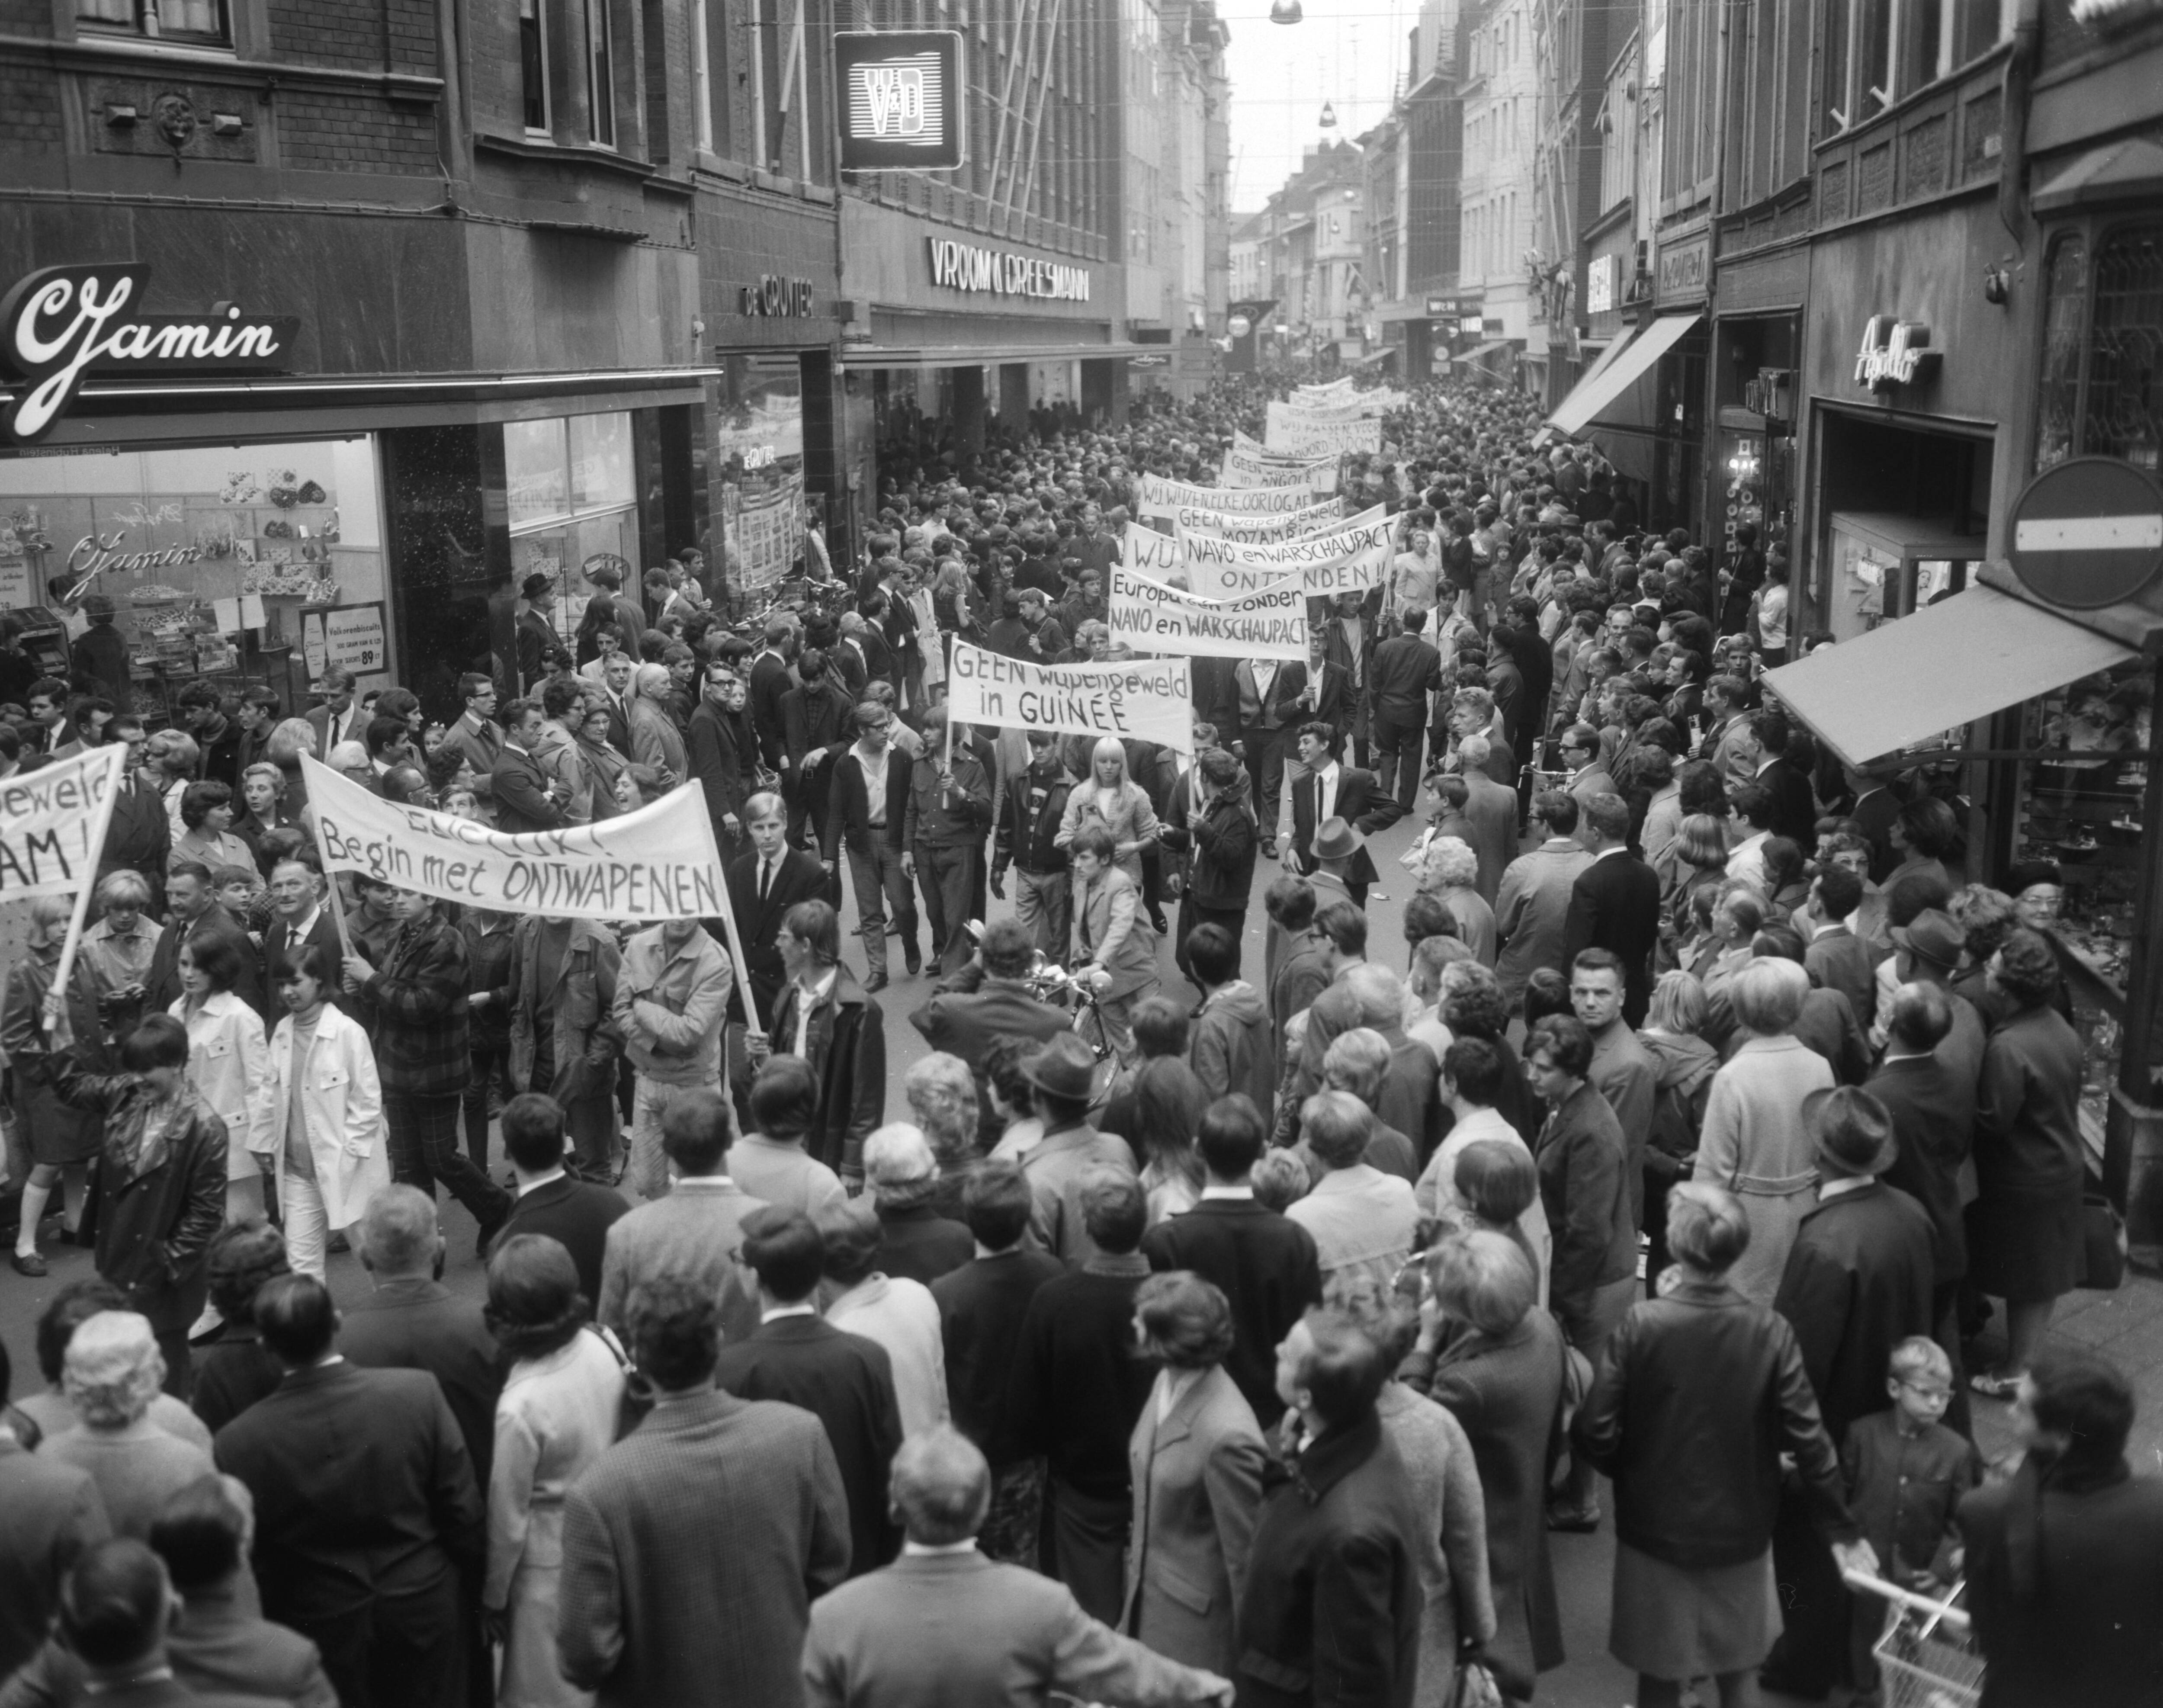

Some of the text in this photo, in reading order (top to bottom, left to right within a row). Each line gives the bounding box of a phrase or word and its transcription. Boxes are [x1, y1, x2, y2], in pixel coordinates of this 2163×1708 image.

[865, 68, 924, 134] V&D
[931, 238, 991, 292] VROOM
[1004, 254, 1089, 301] DREESMANN
[747, 275, 813, 318] DE GRUYTER
[16, 277, 279, 436] Jamin
[1179, 509, 1223, 527] GEEN
[1188, 538, 1235, 563] NAVO
[1264, 523, 1394, 562] WARSCHAUPACT
[64, 530, 202, 601] Jamin
[329, 623, 381, 636] Volkorenbiscuits
[1110, 607, 1306, 645] NAVO en WARSCHAUPACT
[362, 650, 373, 665] 89
[953, 644, 1188, 703] GEEN wapengeweld
[980, 684, 1003, 716] in
[321, 816, 411, 880] Begin
[422, 854, 486, 897] met
[502, 860, 721, 916] ONTWAPENEN
